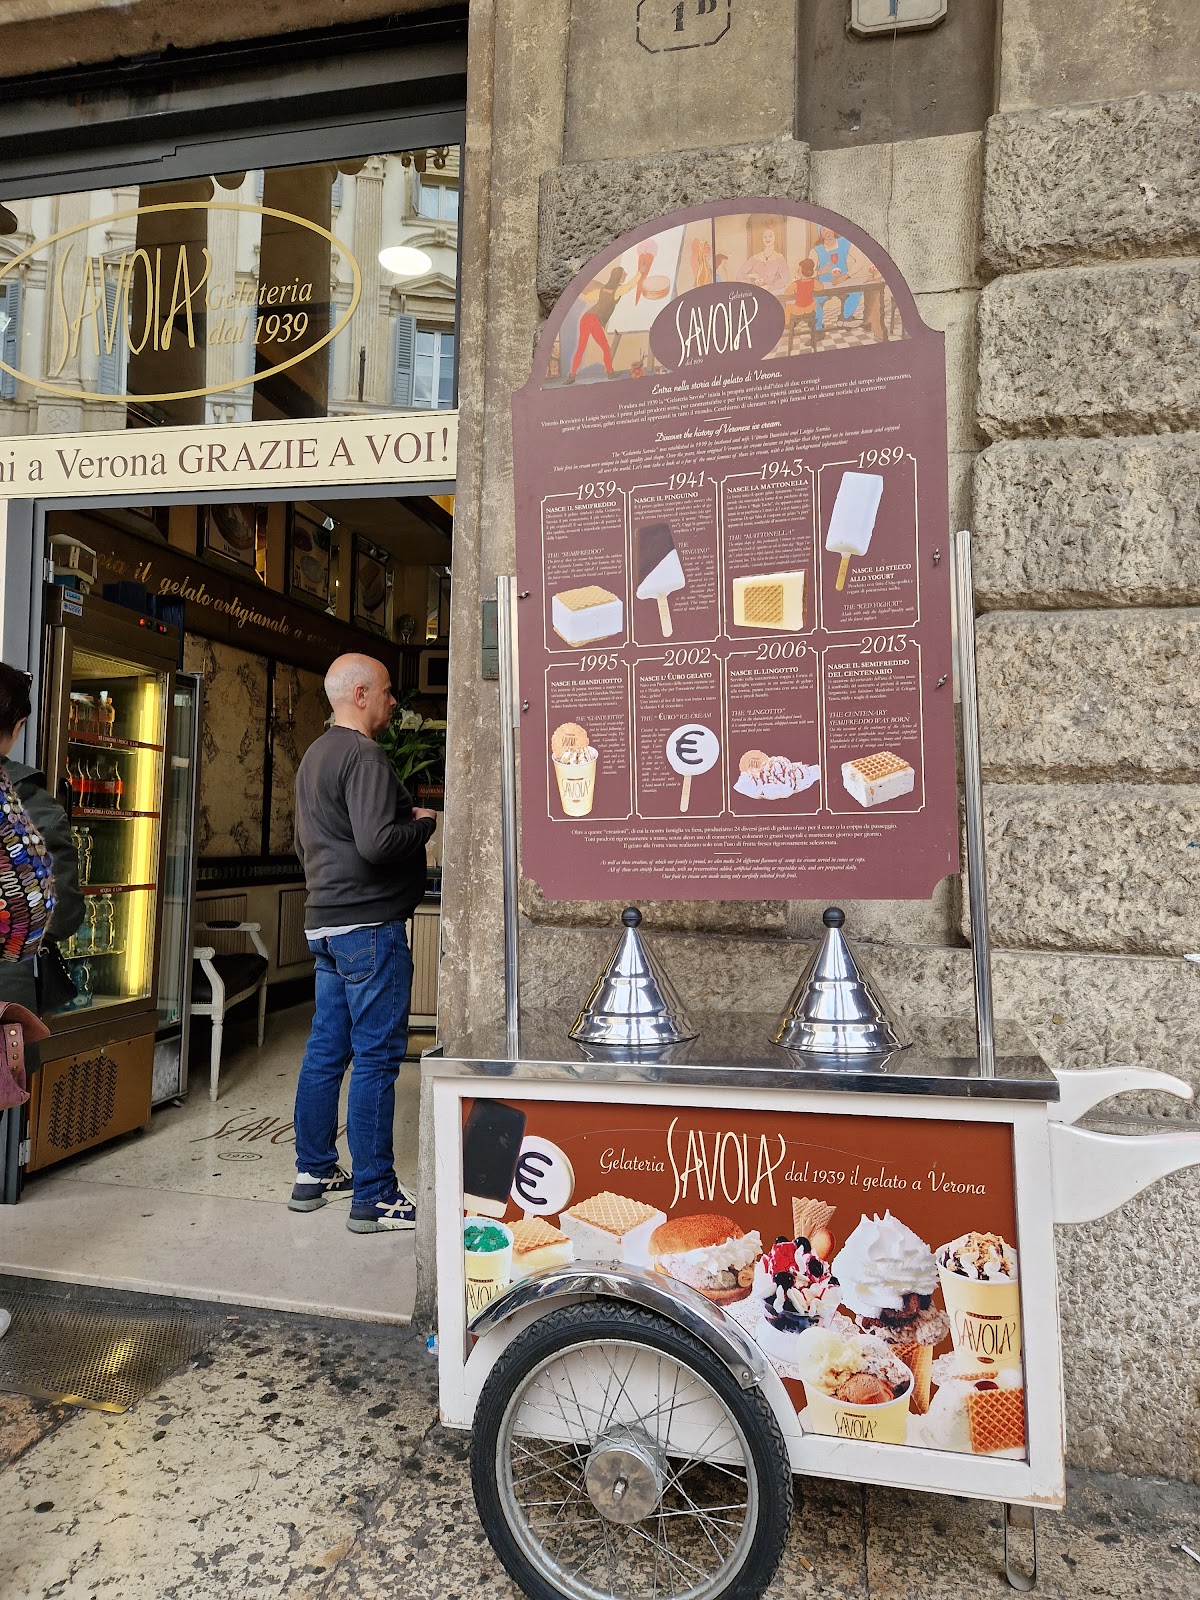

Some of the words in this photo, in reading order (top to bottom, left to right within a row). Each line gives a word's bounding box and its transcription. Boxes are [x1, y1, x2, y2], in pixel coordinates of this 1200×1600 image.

[205, 277, 313, 310] Gelateria
[55, 243, 212, 377] SAVOIA
[206, 316, 248, 345] dal
[252, 312, 309, 344] 1939
[675, 296, 759, 367] SAVOIA
[651, 382, 671, 394] Entra
[673, 379, 689, 391] nella
[691, 379, 709, 389] storia
[711, 375, 722, 386] del
[722, 372, 743, 387] gelato
[744, 370, 752, 381] di
[754, 366, 782, 380] Verona.
[655, 429, 682, 442] Discover
[683, 428, 692, 438] the
[693, 425, 713, 439] history
[714, 423, 724, 436] of
[723, 420, 750, 433] Veronese
[751, 421, 759, 429] ice
[761, 420, 781, 428] cream.
[28, 459, 44, 481] a
[55, 447, 168, 480] Verona
[178, 438, 320, 474] GRAZIE
[329, 441, 355, 467] A
[364, 427, 450, 465] VOI!
[856, 446, 903, 468] 1989
[759, 458, 803, 480] 1943
[576, 479, 616, 500] 1939
[667, 470, 704, 490] 1941
[760, 479, 808, 489] MATTONELLA
[574, 500, 616, 510] SEMIFREDDO
[664, 491, 698, 500] PINGUINO
[885, 563, 911, 571] STECCO
[134, 561, 153, 583] il
[157, 576, 214, 606] gelato
[213, 597, 290, 635] artigianale
[755, 640, 806, 660] 2006
[859, 634, 906, 654] 2013
[579, 653, 618, 672] 1995
[662, 647, 710, 666] 2002
[861, 659, 909, 667] SEMIFREDDO
[762, 666, 798, 674] LINGOTTO
[843, 668, 892, 676] CENTENARIO
[829, 718, 873, 726] SEMIFREDDO
[844, 709, 887, 717] CENTENARY
[600, 1147, 666, 1175] Gelateria
[666, 1116, 786, 1209] SAVOIA
[784, 1160, 809, 1183] dal
[812, 1169, 846, 1185] 1939
[850, 1165, 860, 1186] il
[862, 1166, 907, 1192] gelato
[911, 1178, 922, 1190] a
[927, 1170, 987, 1195] Verona
[954, 1309, 1016, 1355] SAVOIA
[835, 1411, 878, 1439] SAVOIA
